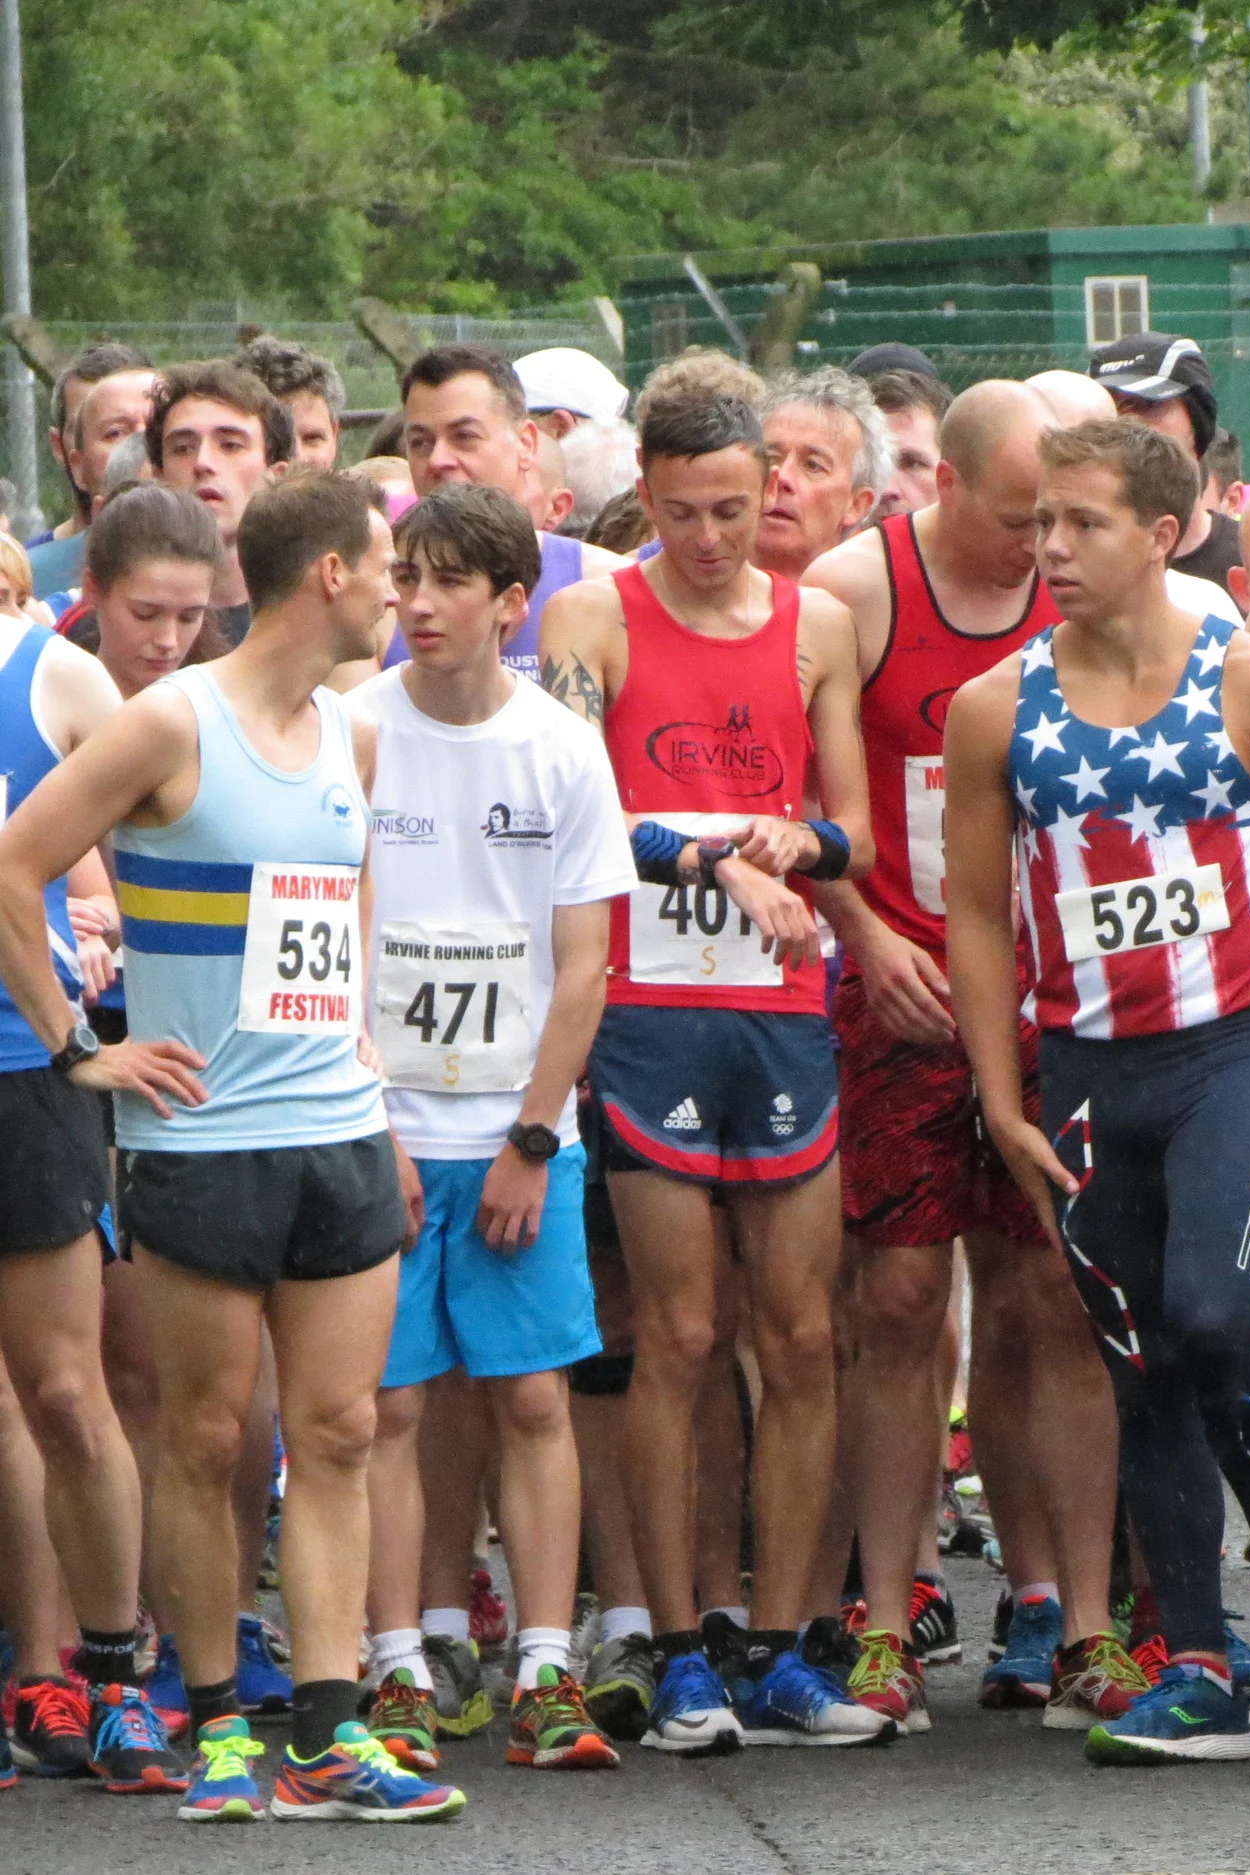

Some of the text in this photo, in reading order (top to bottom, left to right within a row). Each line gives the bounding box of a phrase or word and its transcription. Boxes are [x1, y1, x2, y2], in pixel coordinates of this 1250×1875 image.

[670, 740, 766, 769] IRVINE
[1090, 878, 1200, 950] 523
[277, 920, 351, 983] 534
[385, 940, 526, 961] IRVINE RUNNING CLUB
[404, 981, 499, 1045] 471
[663, 1118, 701, 1129] adidas
